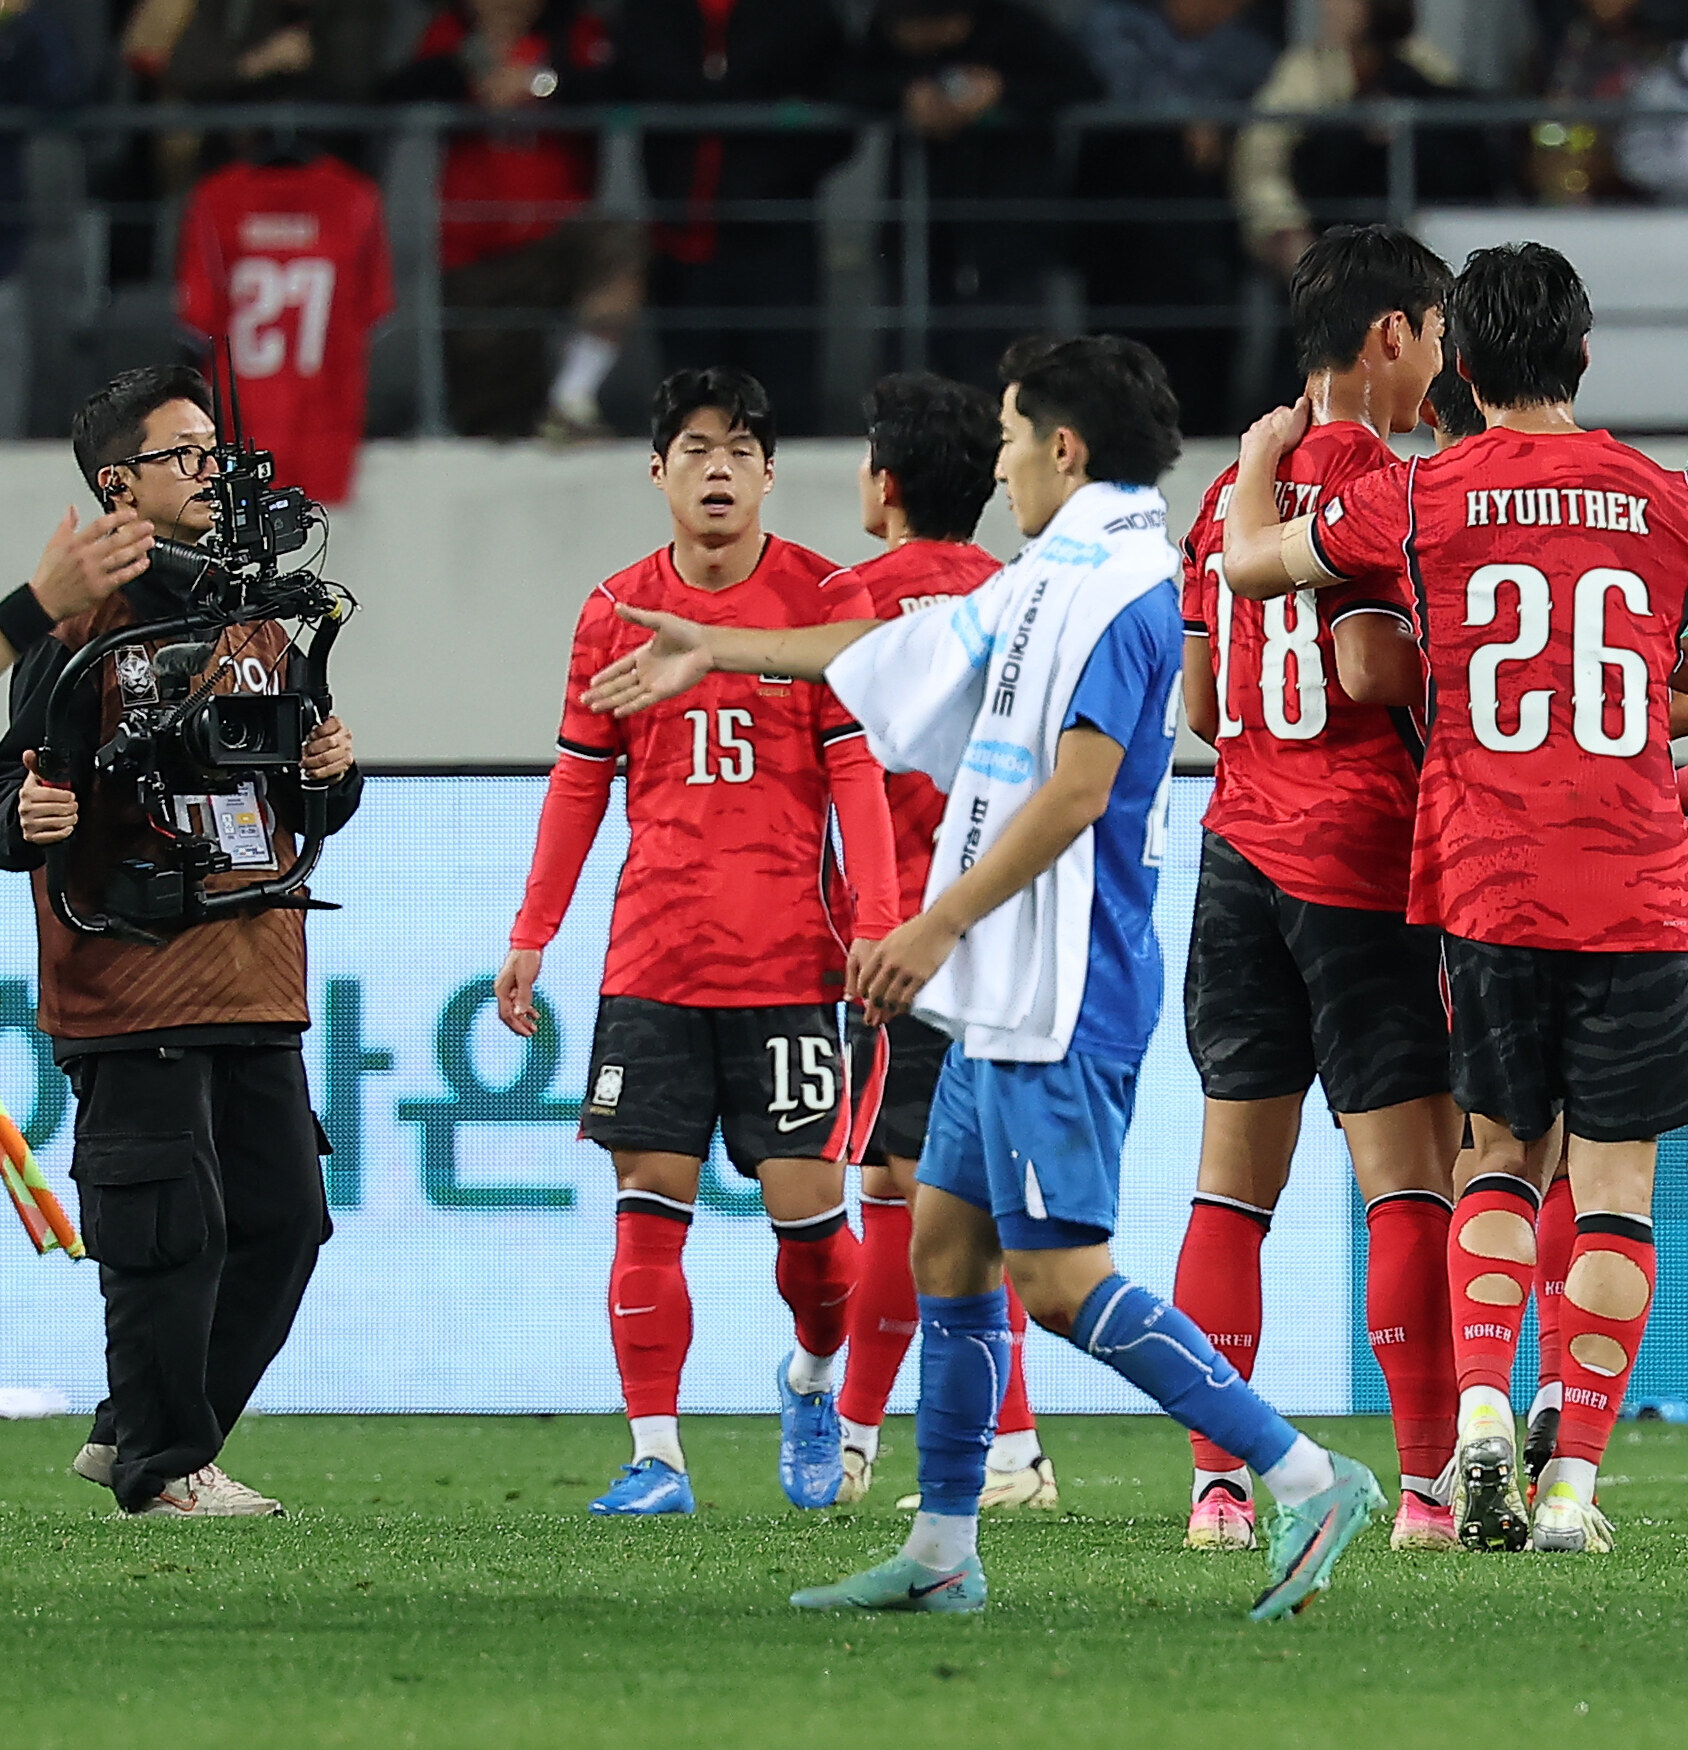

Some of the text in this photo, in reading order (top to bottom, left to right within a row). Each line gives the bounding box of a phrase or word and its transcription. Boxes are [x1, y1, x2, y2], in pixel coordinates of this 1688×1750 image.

[229, 257, 335, 378] 27
[1466, 489, 1651, 535] HYUNTAEK
[1461, 563, 1654, 758] 26
[684, 708, 756, 787] 15
[765, 1036, 836, 1113] 15
[1207, 1332, 1253, 1348] OREA
[1368, 1326, 1406, 1346] OREA
[1464, 1323, 1513, 1343] KOREA
[1564, 1386, 1608, 1411] KOREA
